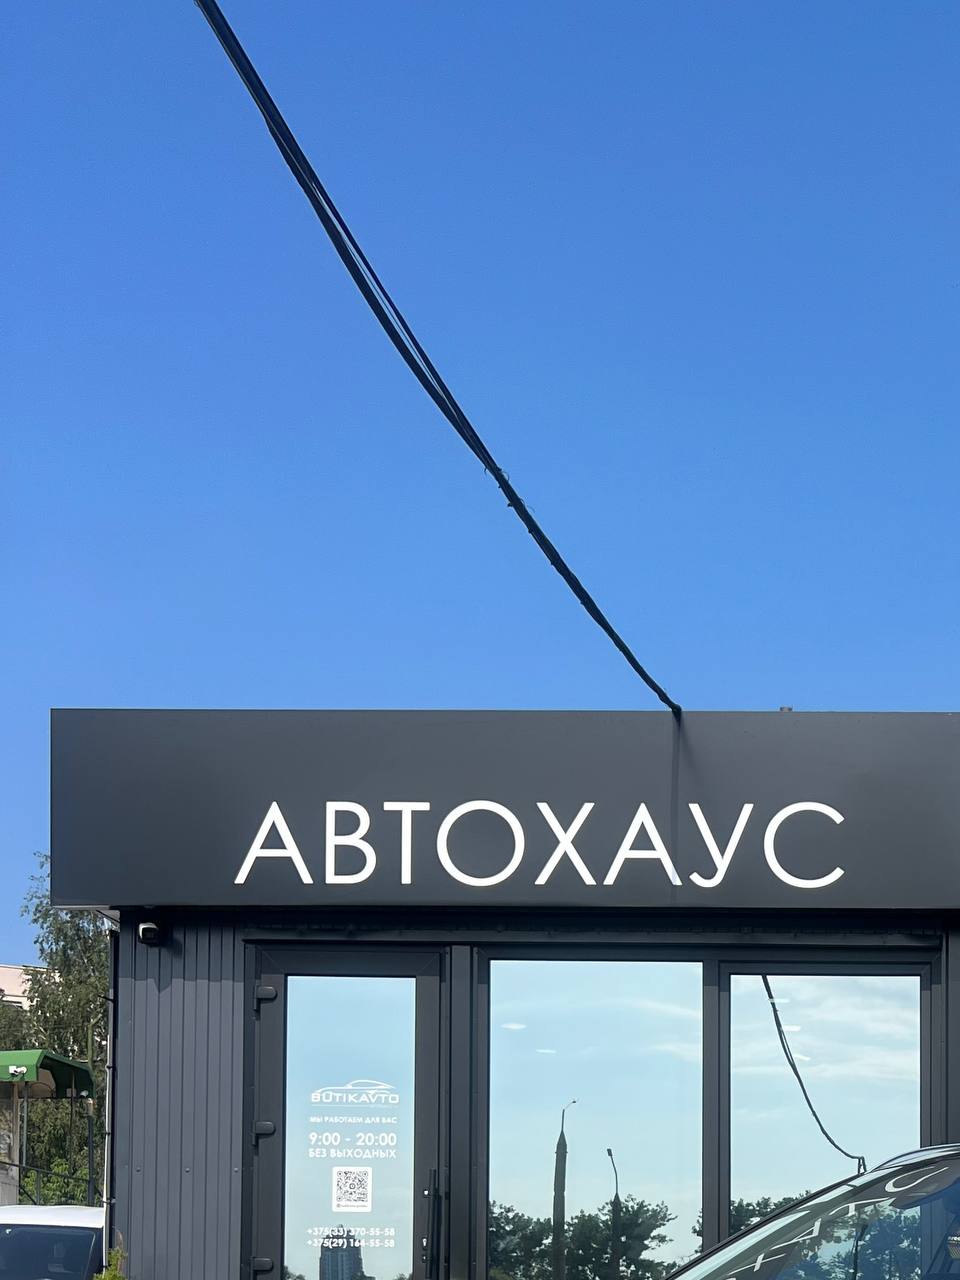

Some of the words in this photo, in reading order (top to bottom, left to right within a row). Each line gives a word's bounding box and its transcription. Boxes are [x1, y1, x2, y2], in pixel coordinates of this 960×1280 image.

[233, 799, 846, 890] АВТОХАУС
[311, 1092, 400, 1104] BUTIKAVTO
[309, 1132, 341, 1146] 9:00
[356, 1132, 397, 1146] 20:00
[308, 1148, 327, 1158] БЕЗ
[329, 1148, 397, 1159] ВЫХОДНЫХ
